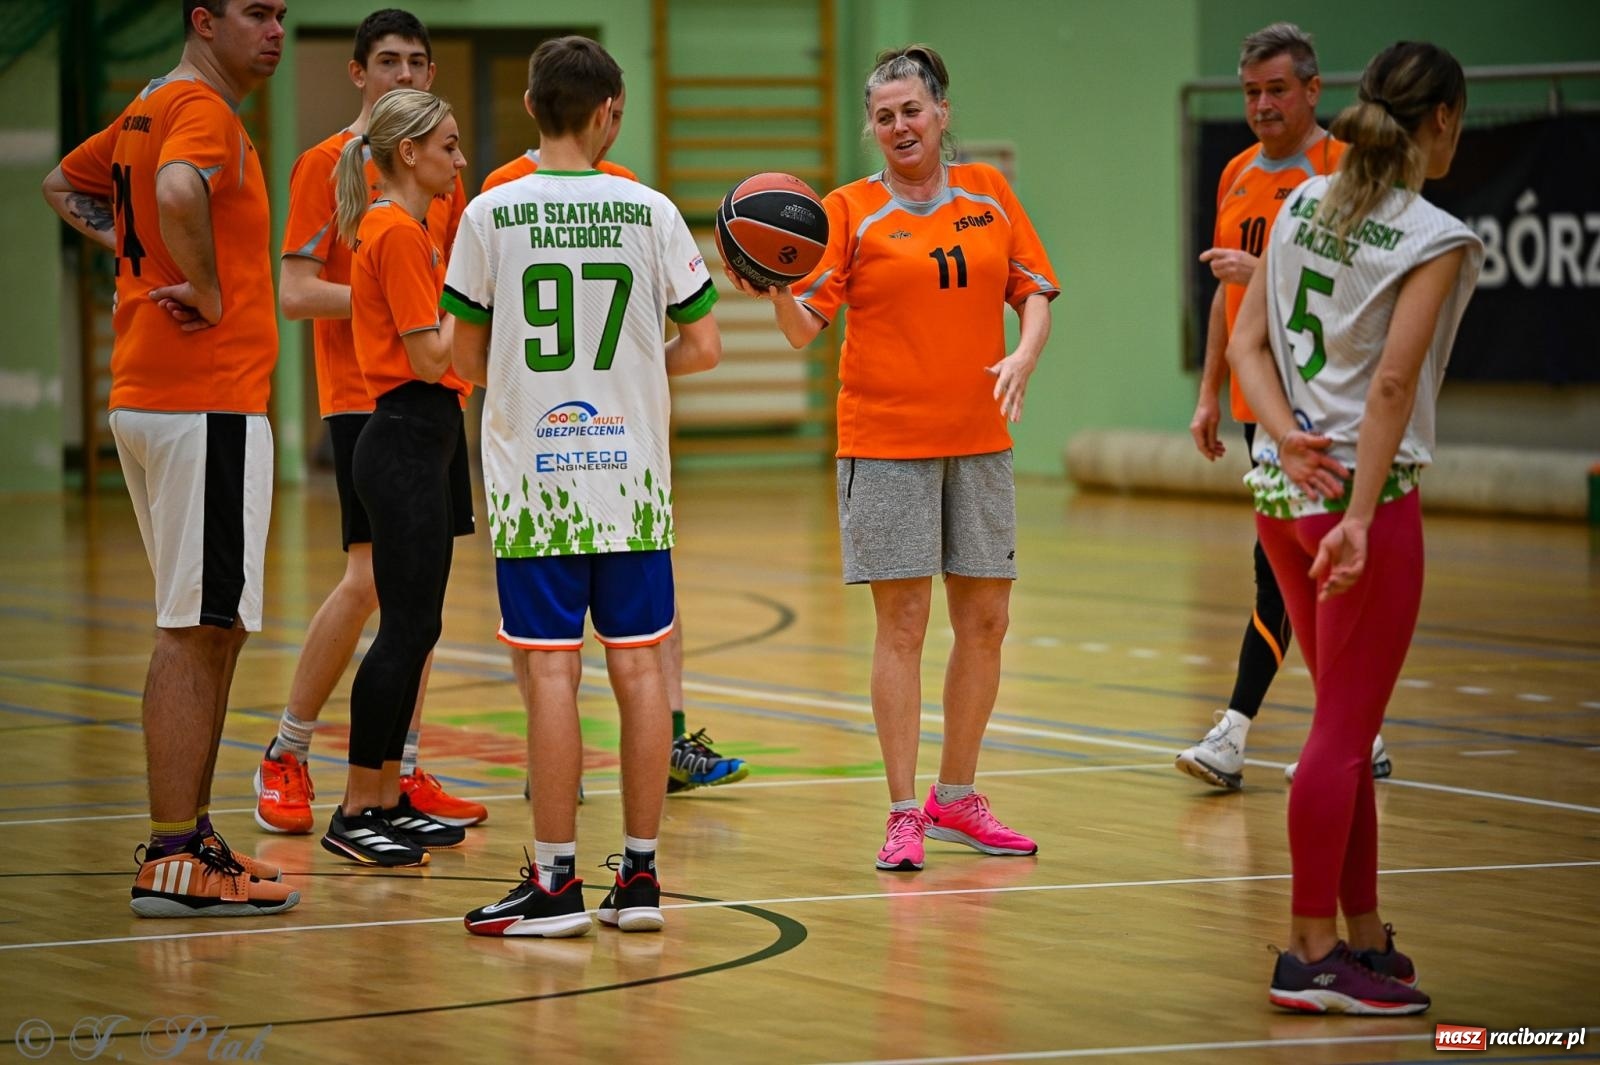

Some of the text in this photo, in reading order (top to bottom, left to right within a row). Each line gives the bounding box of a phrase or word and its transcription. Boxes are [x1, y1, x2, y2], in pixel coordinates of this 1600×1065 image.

[492, 201, 652, 229] KLUB SIATKARSKI
[953, 210, 994, 232] ZSOMS
[530, 223, 623, 248] RACIBÓRZ
[1239, 216, 1266, 258] 10
[929, 245, 968, 289] 11
[522, 262, 634, 372] 97
[1290, 265, 1336, 383] 5
[536, 425, 625, 438] UBEZPIECZENIA
[592, 416, 624, 425] MULTI
